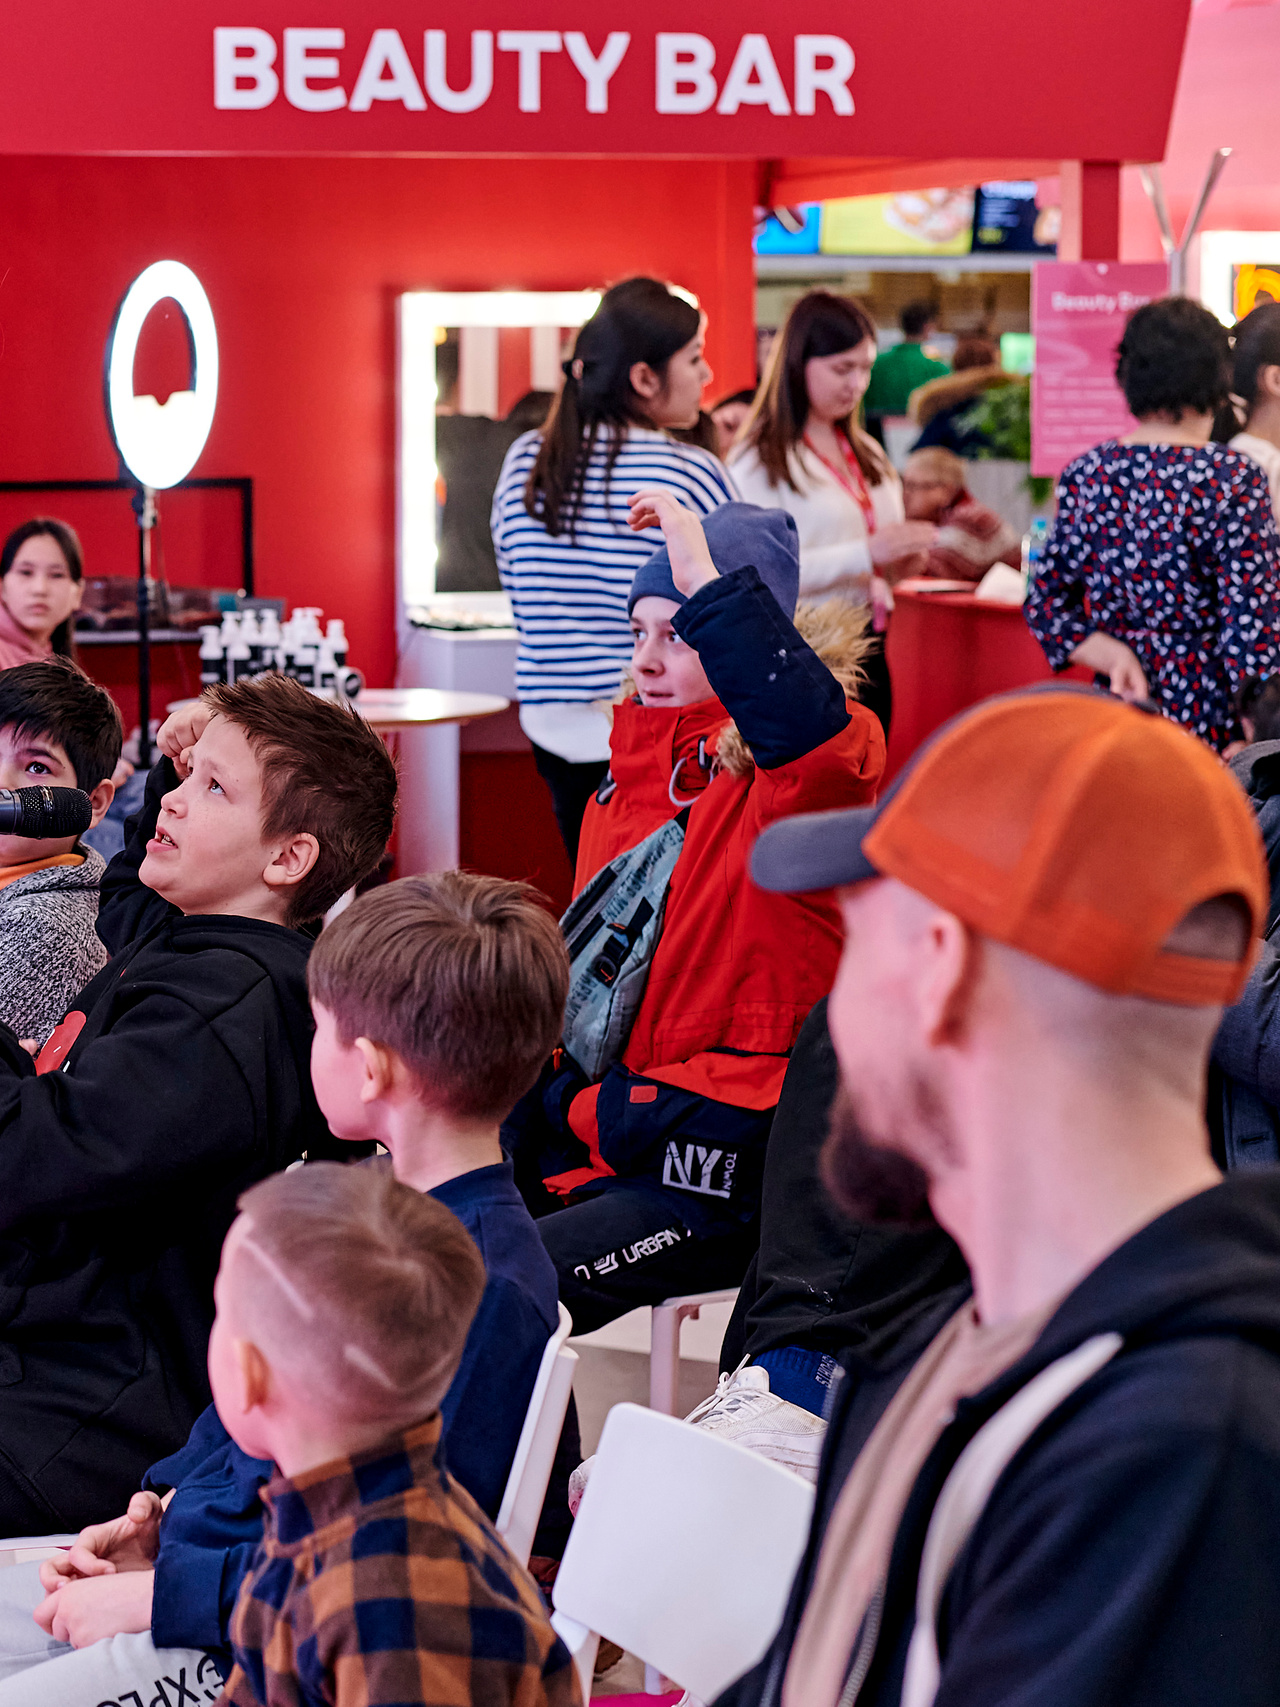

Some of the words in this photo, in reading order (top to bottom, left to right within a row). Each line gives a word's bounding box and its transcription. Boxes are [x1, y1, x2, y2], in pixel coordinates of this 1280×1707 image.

[214, 26, 631, 113] BEAUTY
[655, 32, 855, 115] BAR
[1051, 291, 1116, 314] Beauty
[662, 1141, 726, 1194] NY
[722, 1152, 737, 1191] TOWN
[622, 1227, 681, 1264] URBAN
